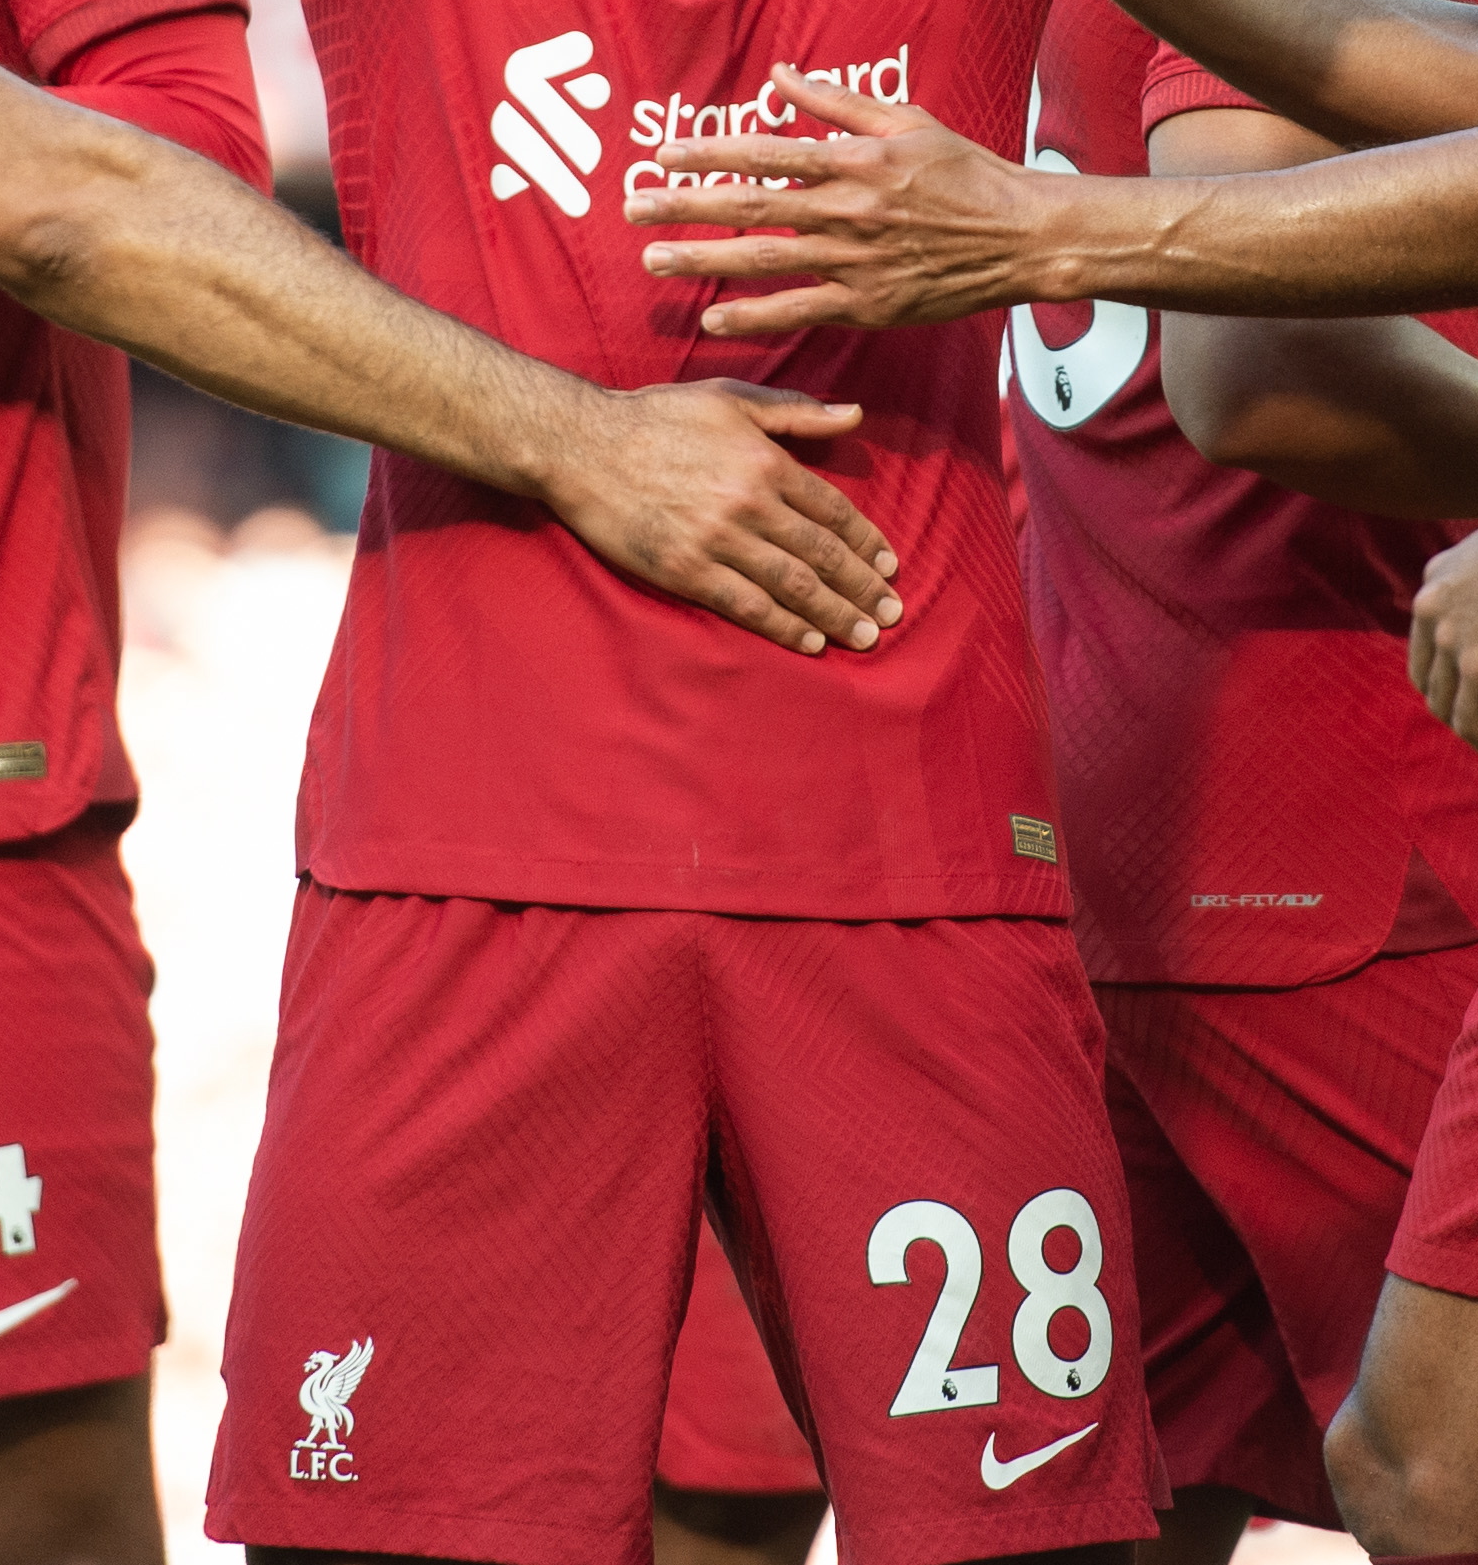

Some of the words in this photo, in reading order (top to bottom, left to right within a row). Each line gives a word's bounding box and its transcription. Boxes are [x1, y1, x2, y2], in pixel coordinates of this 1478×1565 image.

[628, 43, 909, 147] standrd
[866, 1187, 1114, 1418] 28
[289, 1449, 360, 1482] L.F.C.
